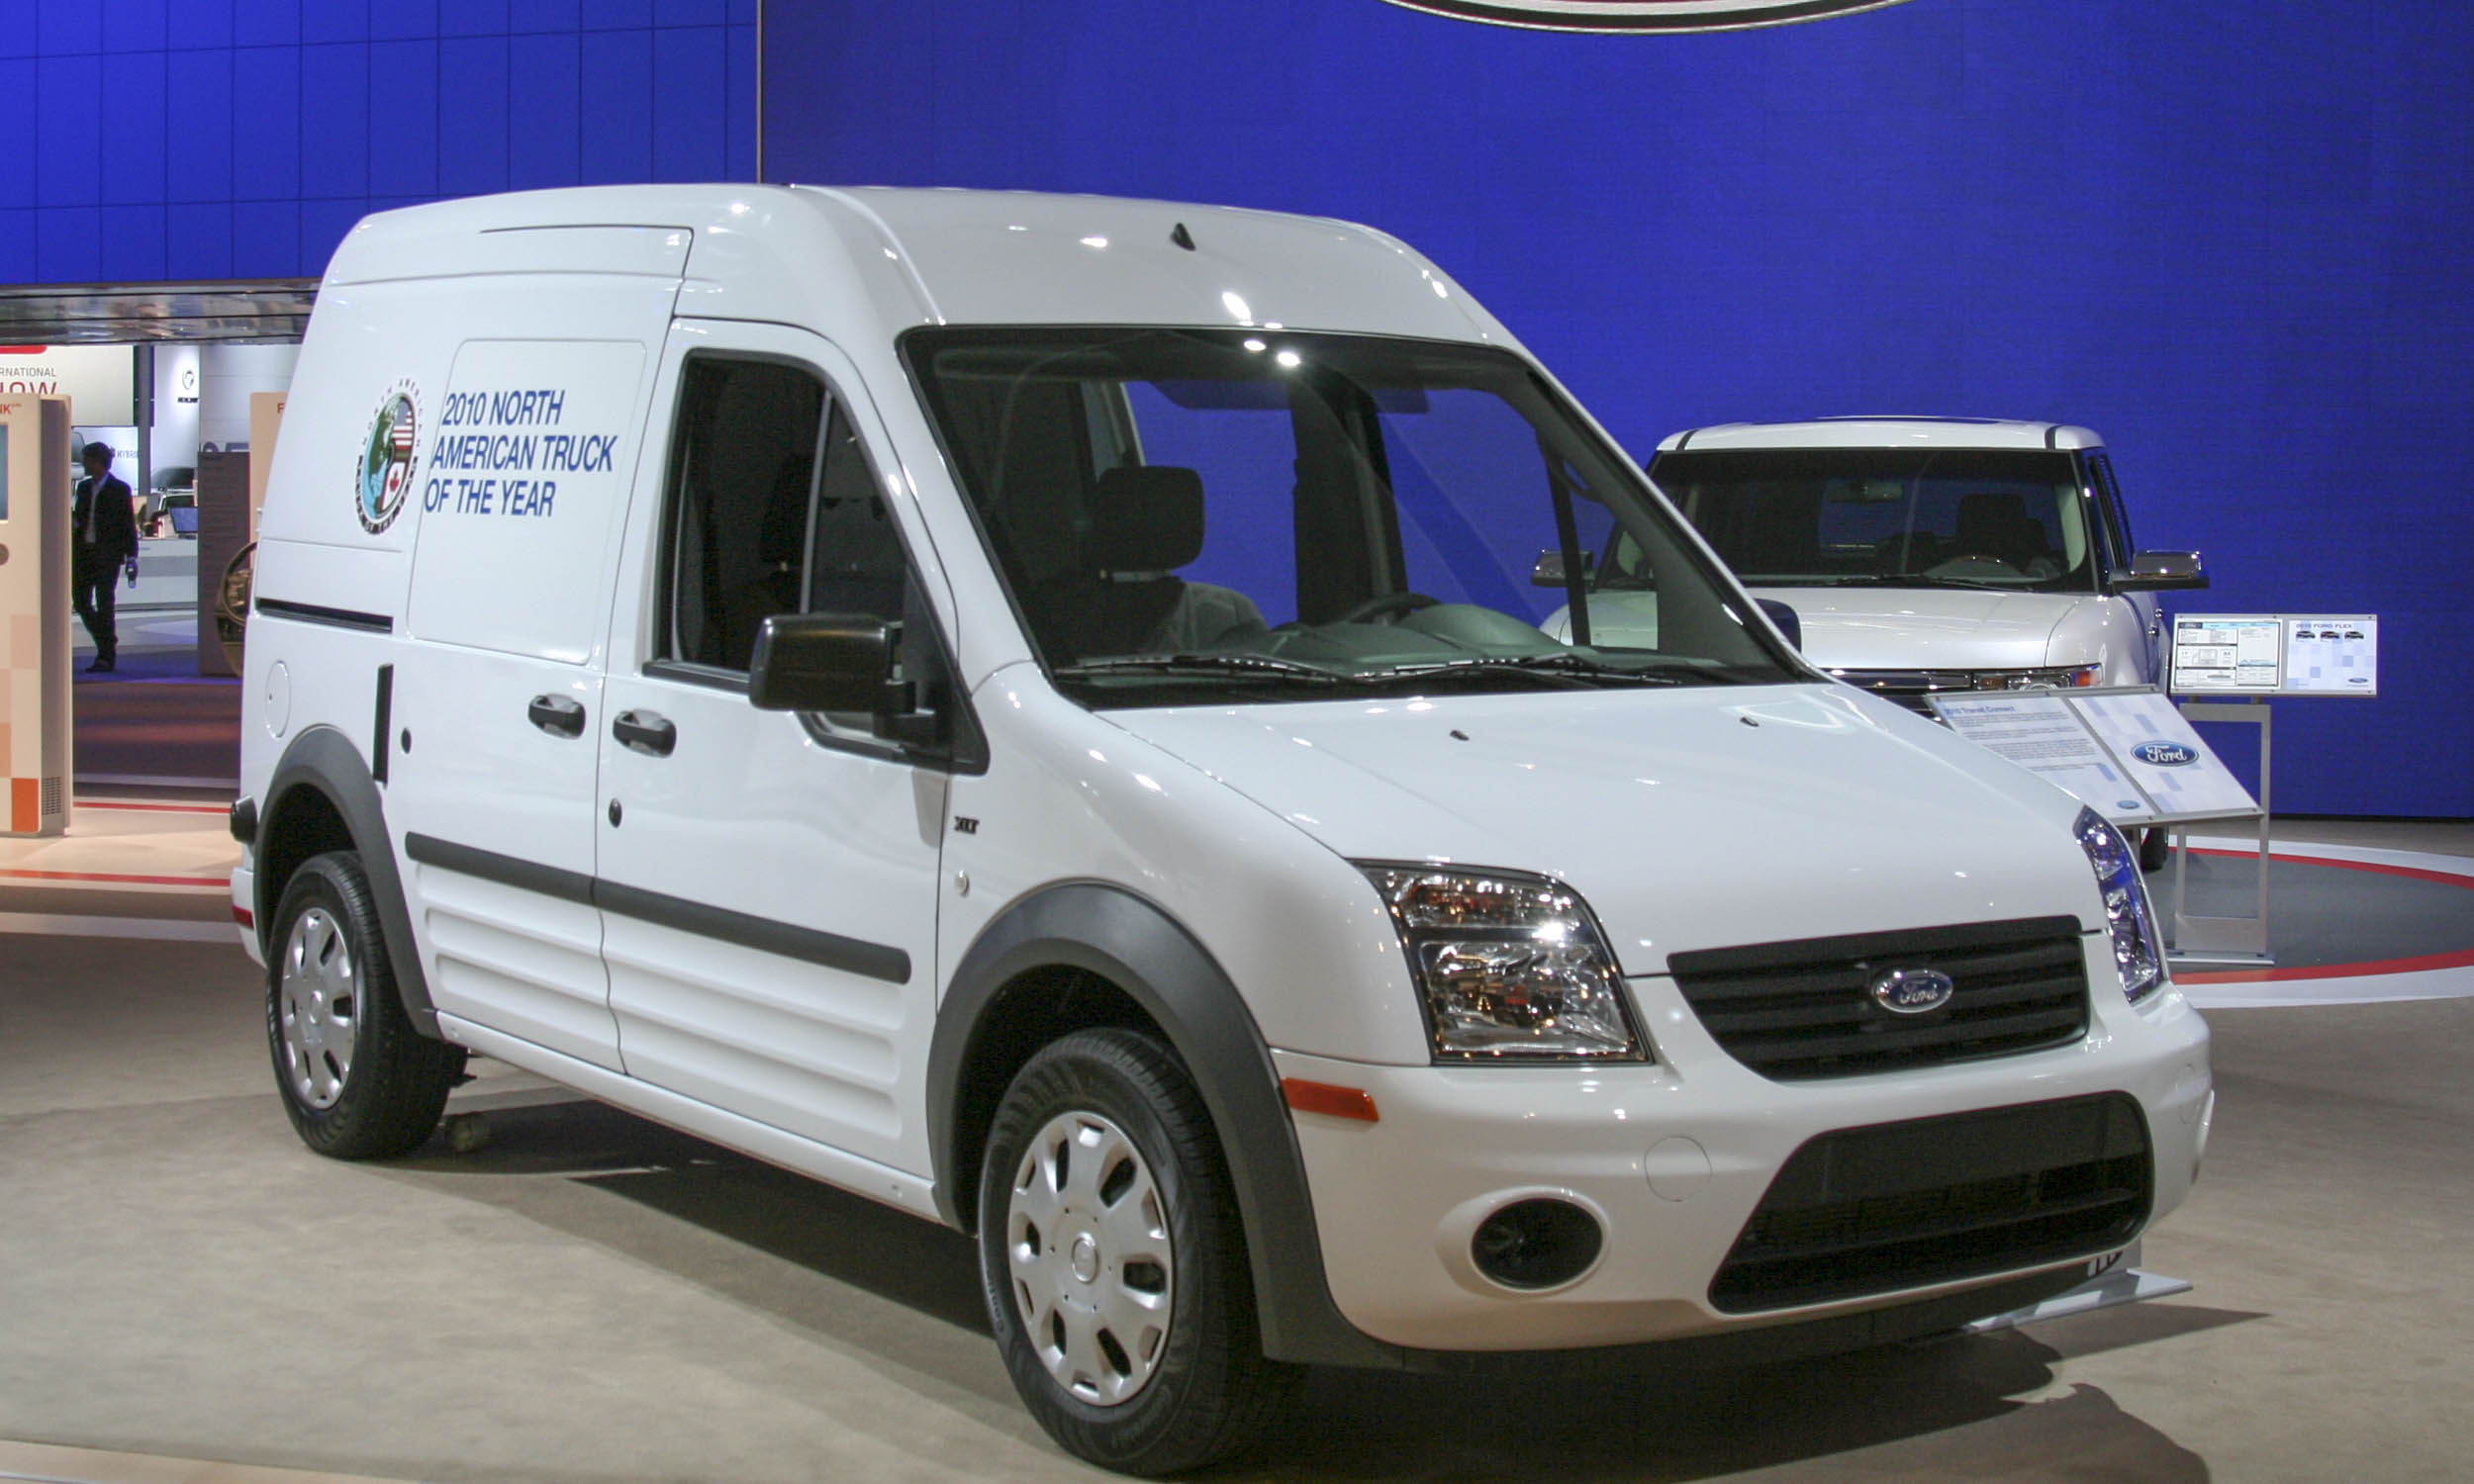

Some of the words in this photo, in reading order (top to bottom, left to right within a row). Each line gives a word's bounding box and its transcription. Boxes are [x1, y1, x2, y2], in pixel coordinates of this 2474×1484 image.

[441, 393, 487, 425] 2010
[489, 390, 565, 425] NORTH
[429, 434, 537, 470] AMERICAN
[541, 434, 618, 472] TRUCK
[425, 478, 452, 512] OF
[456, 479, 497, 514] THE
[501, 480, 556, 517] YEAR
[2145, 745, 2187, 763] Ford
[1899, 977, 1939, 1005] Ford
